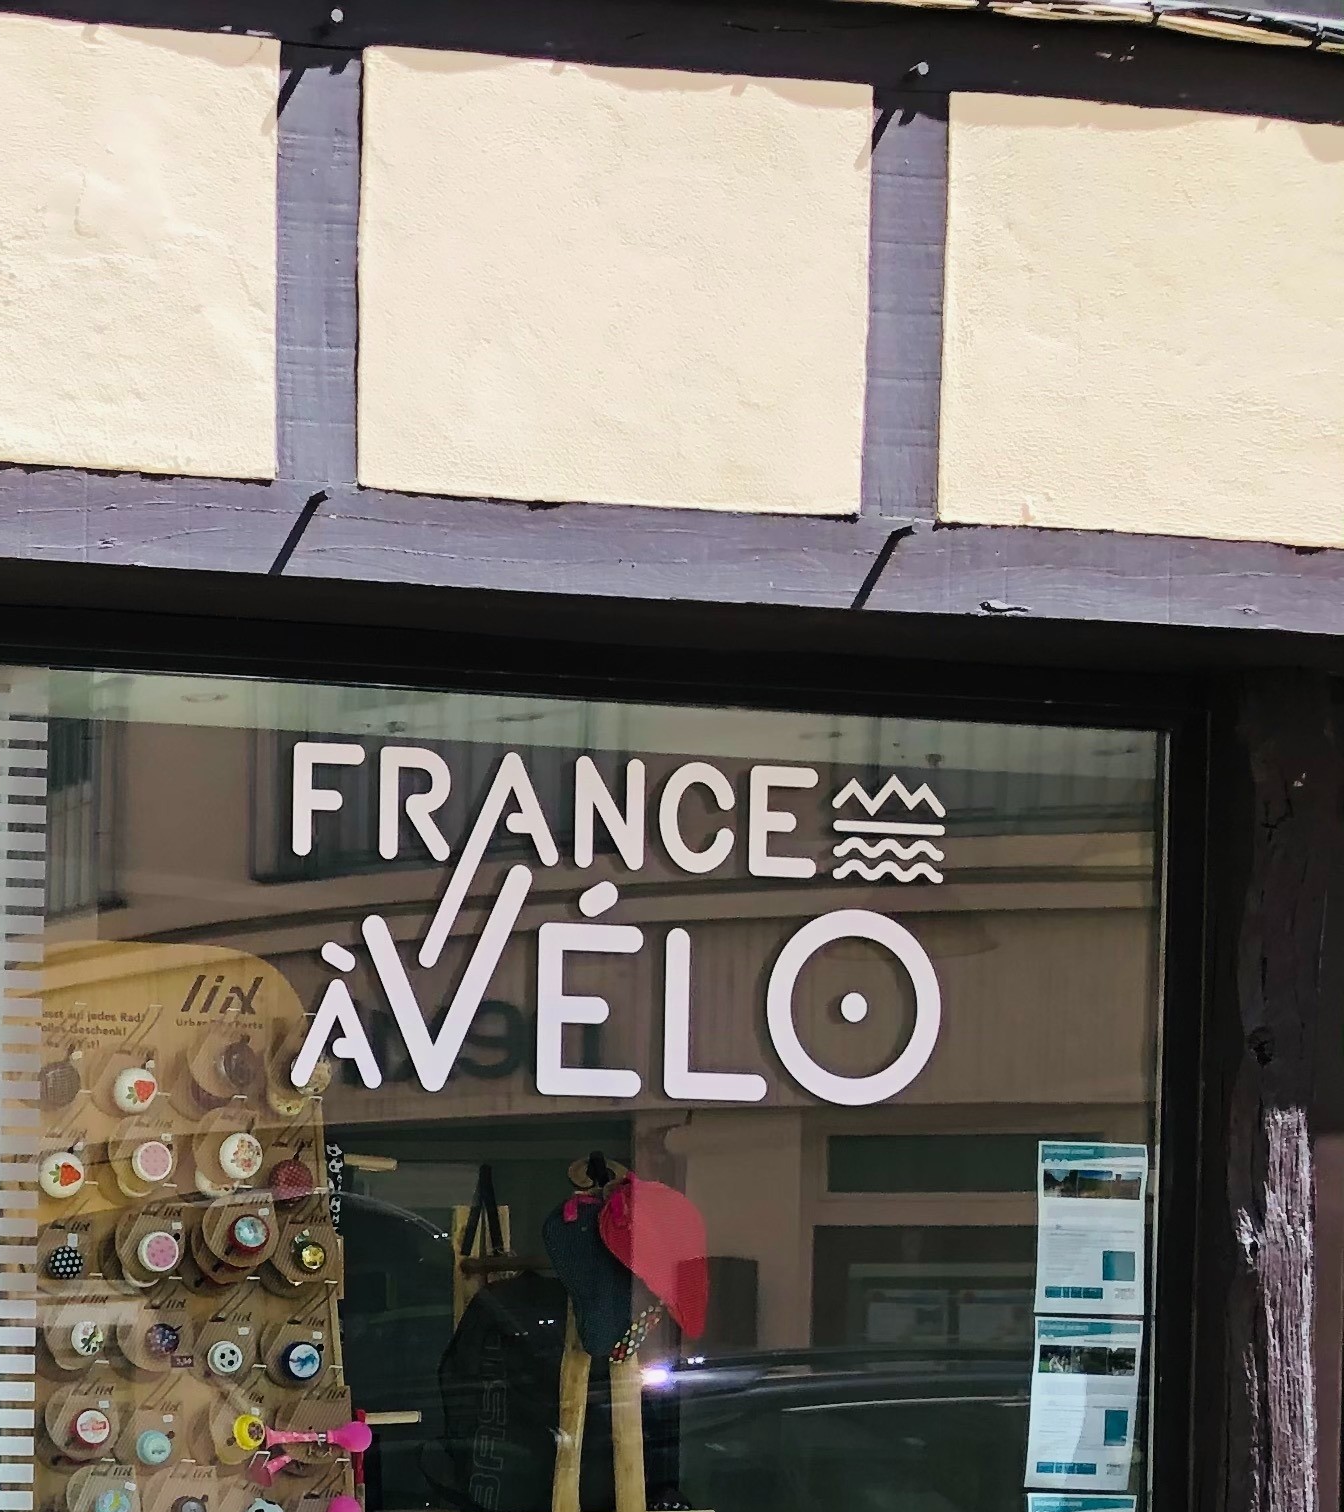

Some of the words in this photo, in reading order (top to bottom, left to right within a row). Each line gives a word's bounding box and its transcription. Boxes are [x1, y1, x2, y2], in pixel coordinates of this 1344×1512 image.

[292, 741, 817, 968] FRANCE
[291, 941, 383, 1089] À
[363, 863, 942, 1106] VÉLO
